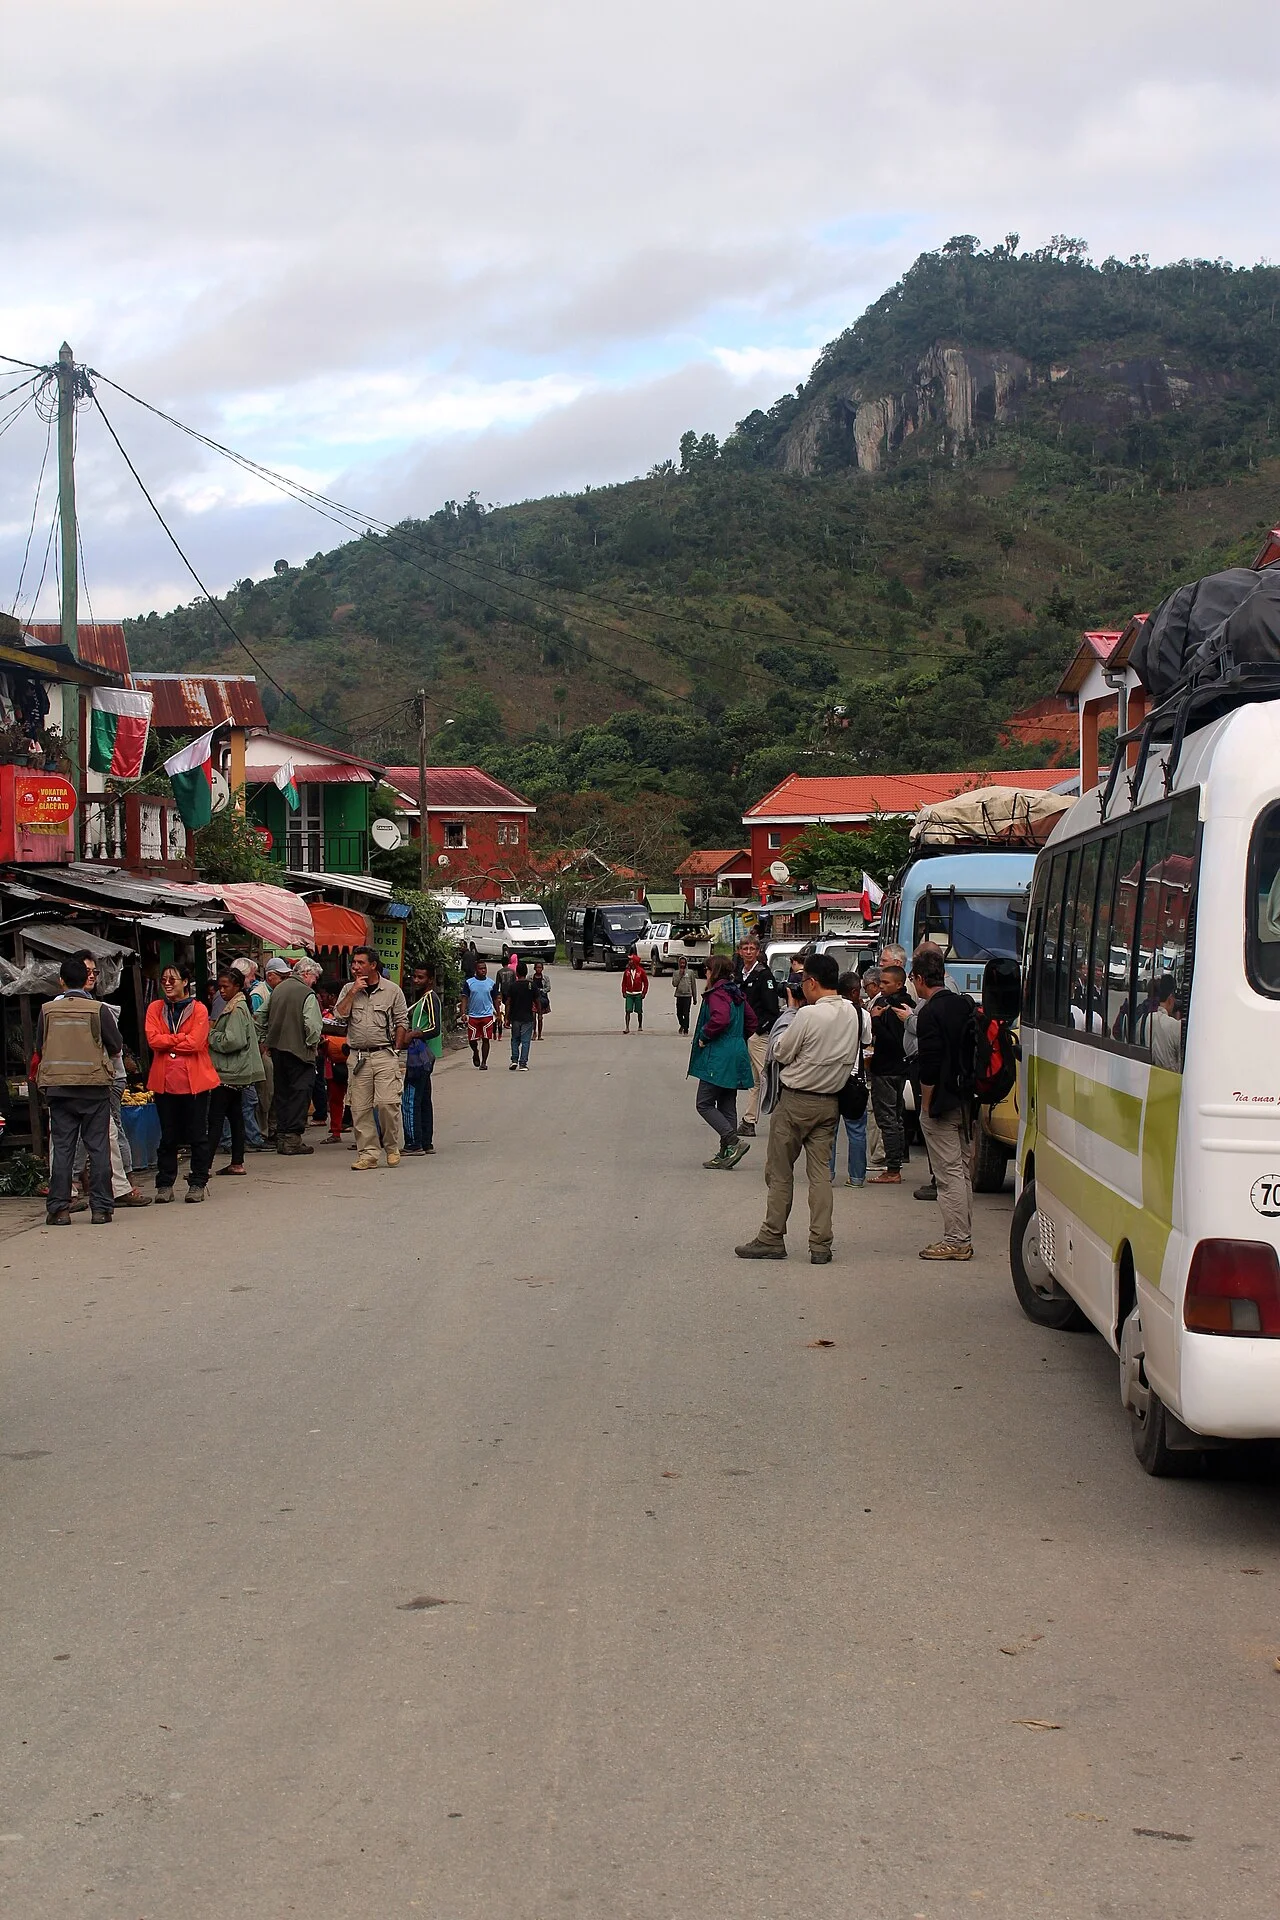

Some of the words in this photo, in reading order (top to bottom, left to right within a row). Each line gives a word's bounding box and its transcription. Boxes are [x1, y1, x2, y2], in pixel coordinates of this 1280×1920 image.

[40, 788, 68, 796] VOKATRA
[57, 802, 69, 810] ATO
[1232, 1091, 1249, 1102] Tia
